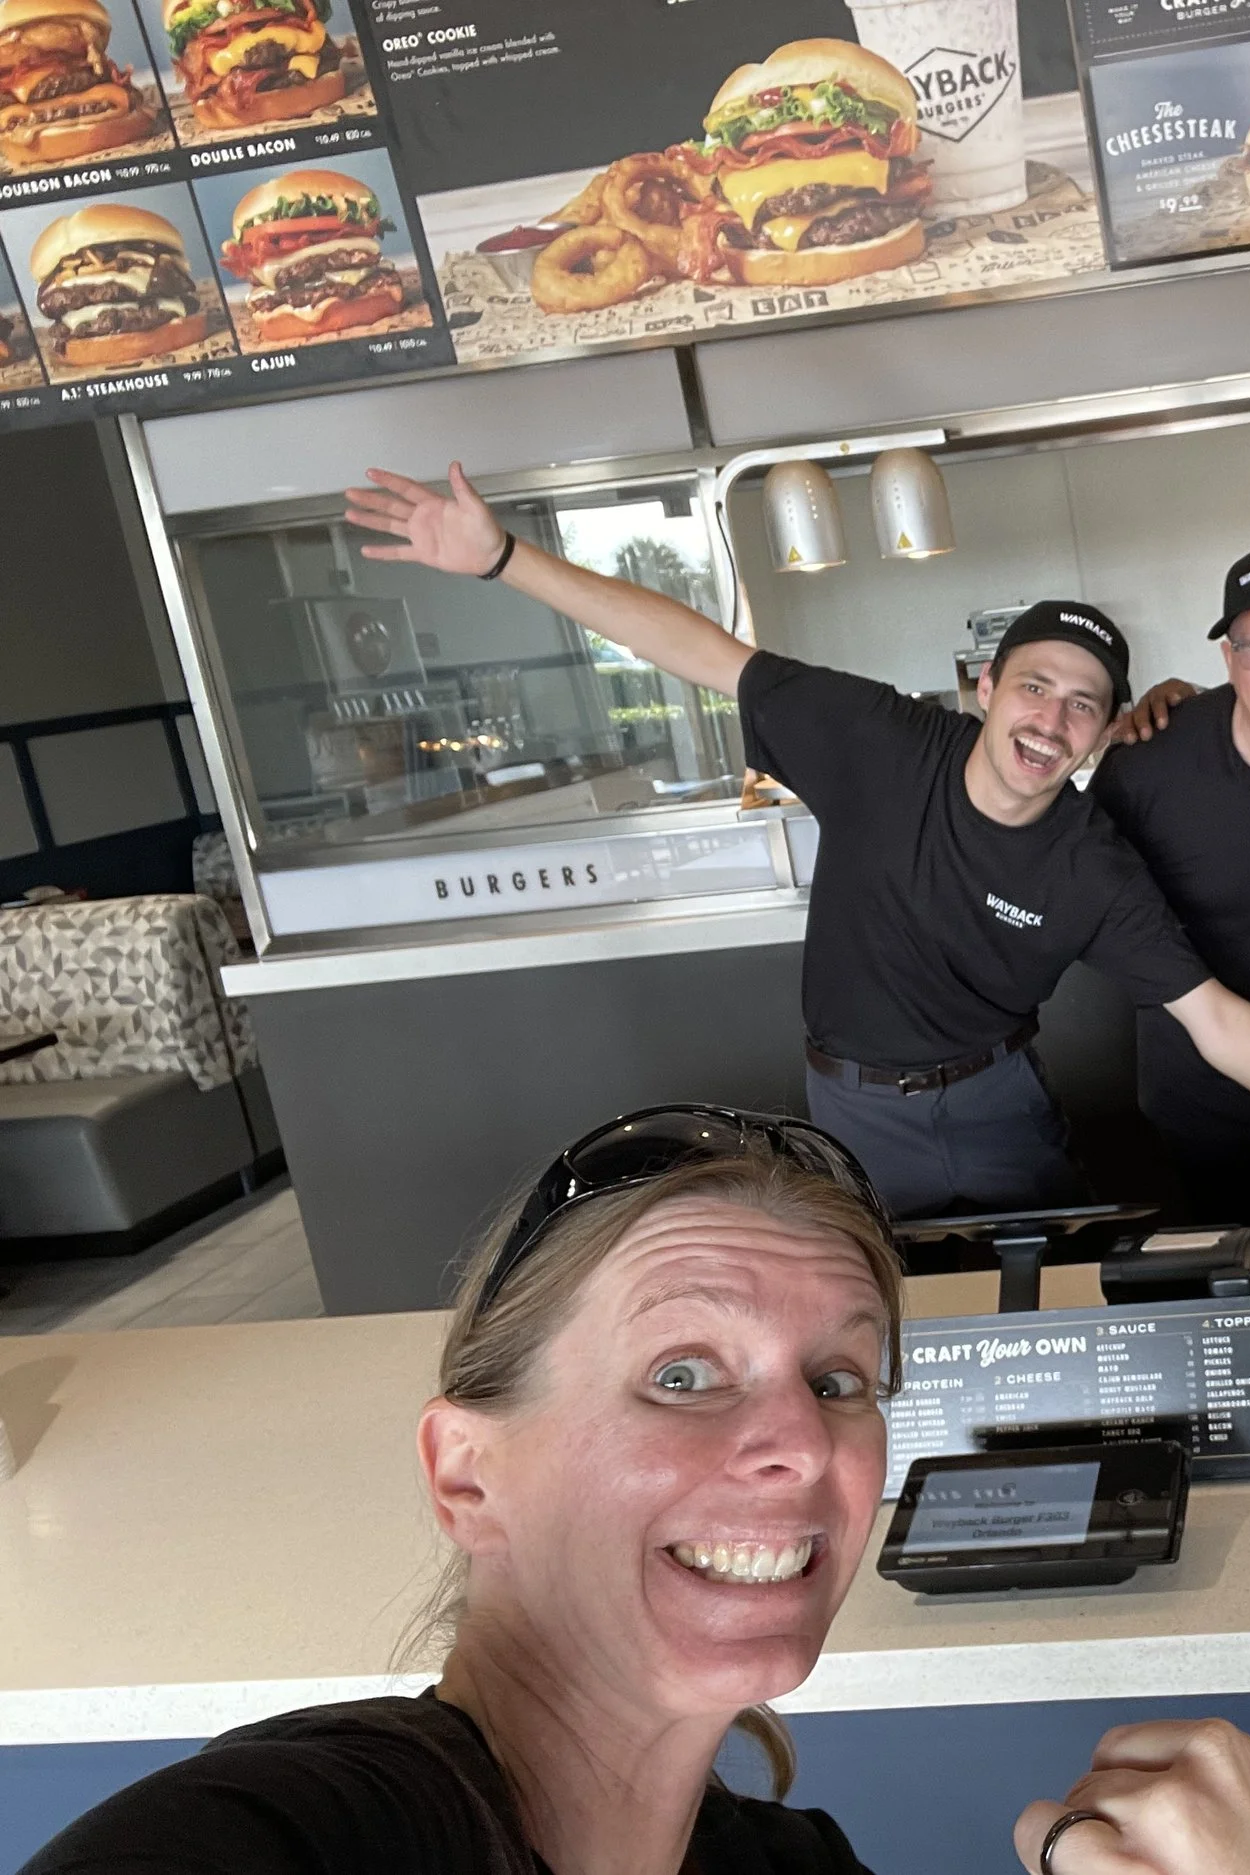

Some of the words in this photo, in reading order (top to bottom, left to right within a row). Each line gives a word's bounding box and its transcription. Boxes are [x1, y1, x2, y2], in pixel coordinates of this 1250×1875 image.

[1176, 4, 1227, 20] BURGER
[427, 24, 477, 44] COOKIE
[505, 34, 537, 48] blended
[500, 48, 533, 62] whipped
[907, 49, 1010, 101] YBACK
[1154, 100, 1184, 121] The
[1105, 118, 1237, 156] CHEESESTEAK
[190, 146, 244, 167] DOUBLE
[247, 138, 295, 157] BACON
[64, 169, 112, 188] BACON
[251, 354, 296, 372] CAJUN
[86, 373, 169, 397] STEAKHOUSE
[1059, 612, 1114, 645] WAYBACK
[435, 862, 599, 900] BURGERS
[986, 892, 1043, 926] WAYBACK
[1108, 1323, 1156, 1336] SAUCE
[1202, 1336, 1231, 1344] LETTUCE
[912, 1344, 972, 1365] CRAFT
[976, 1338, 1032, 1368] Your
[1035, 1336, 1087, 1355] OWN
[1203, 1347, 1233, 1355] TOMATO
[1203, 1358, 1231, 1366] PICKLES
[904, 1378, 964, 1391] PROTEIN
[1006, 1371, 1062, 1385] CHEESE
[1208, 1422, 1232, 1431] BACON
[932, 1517, 988, 1530] Wayback
[992, 1514, 1034, 1526] Burger
[972, 1528, 1023, 1539] Orlando
